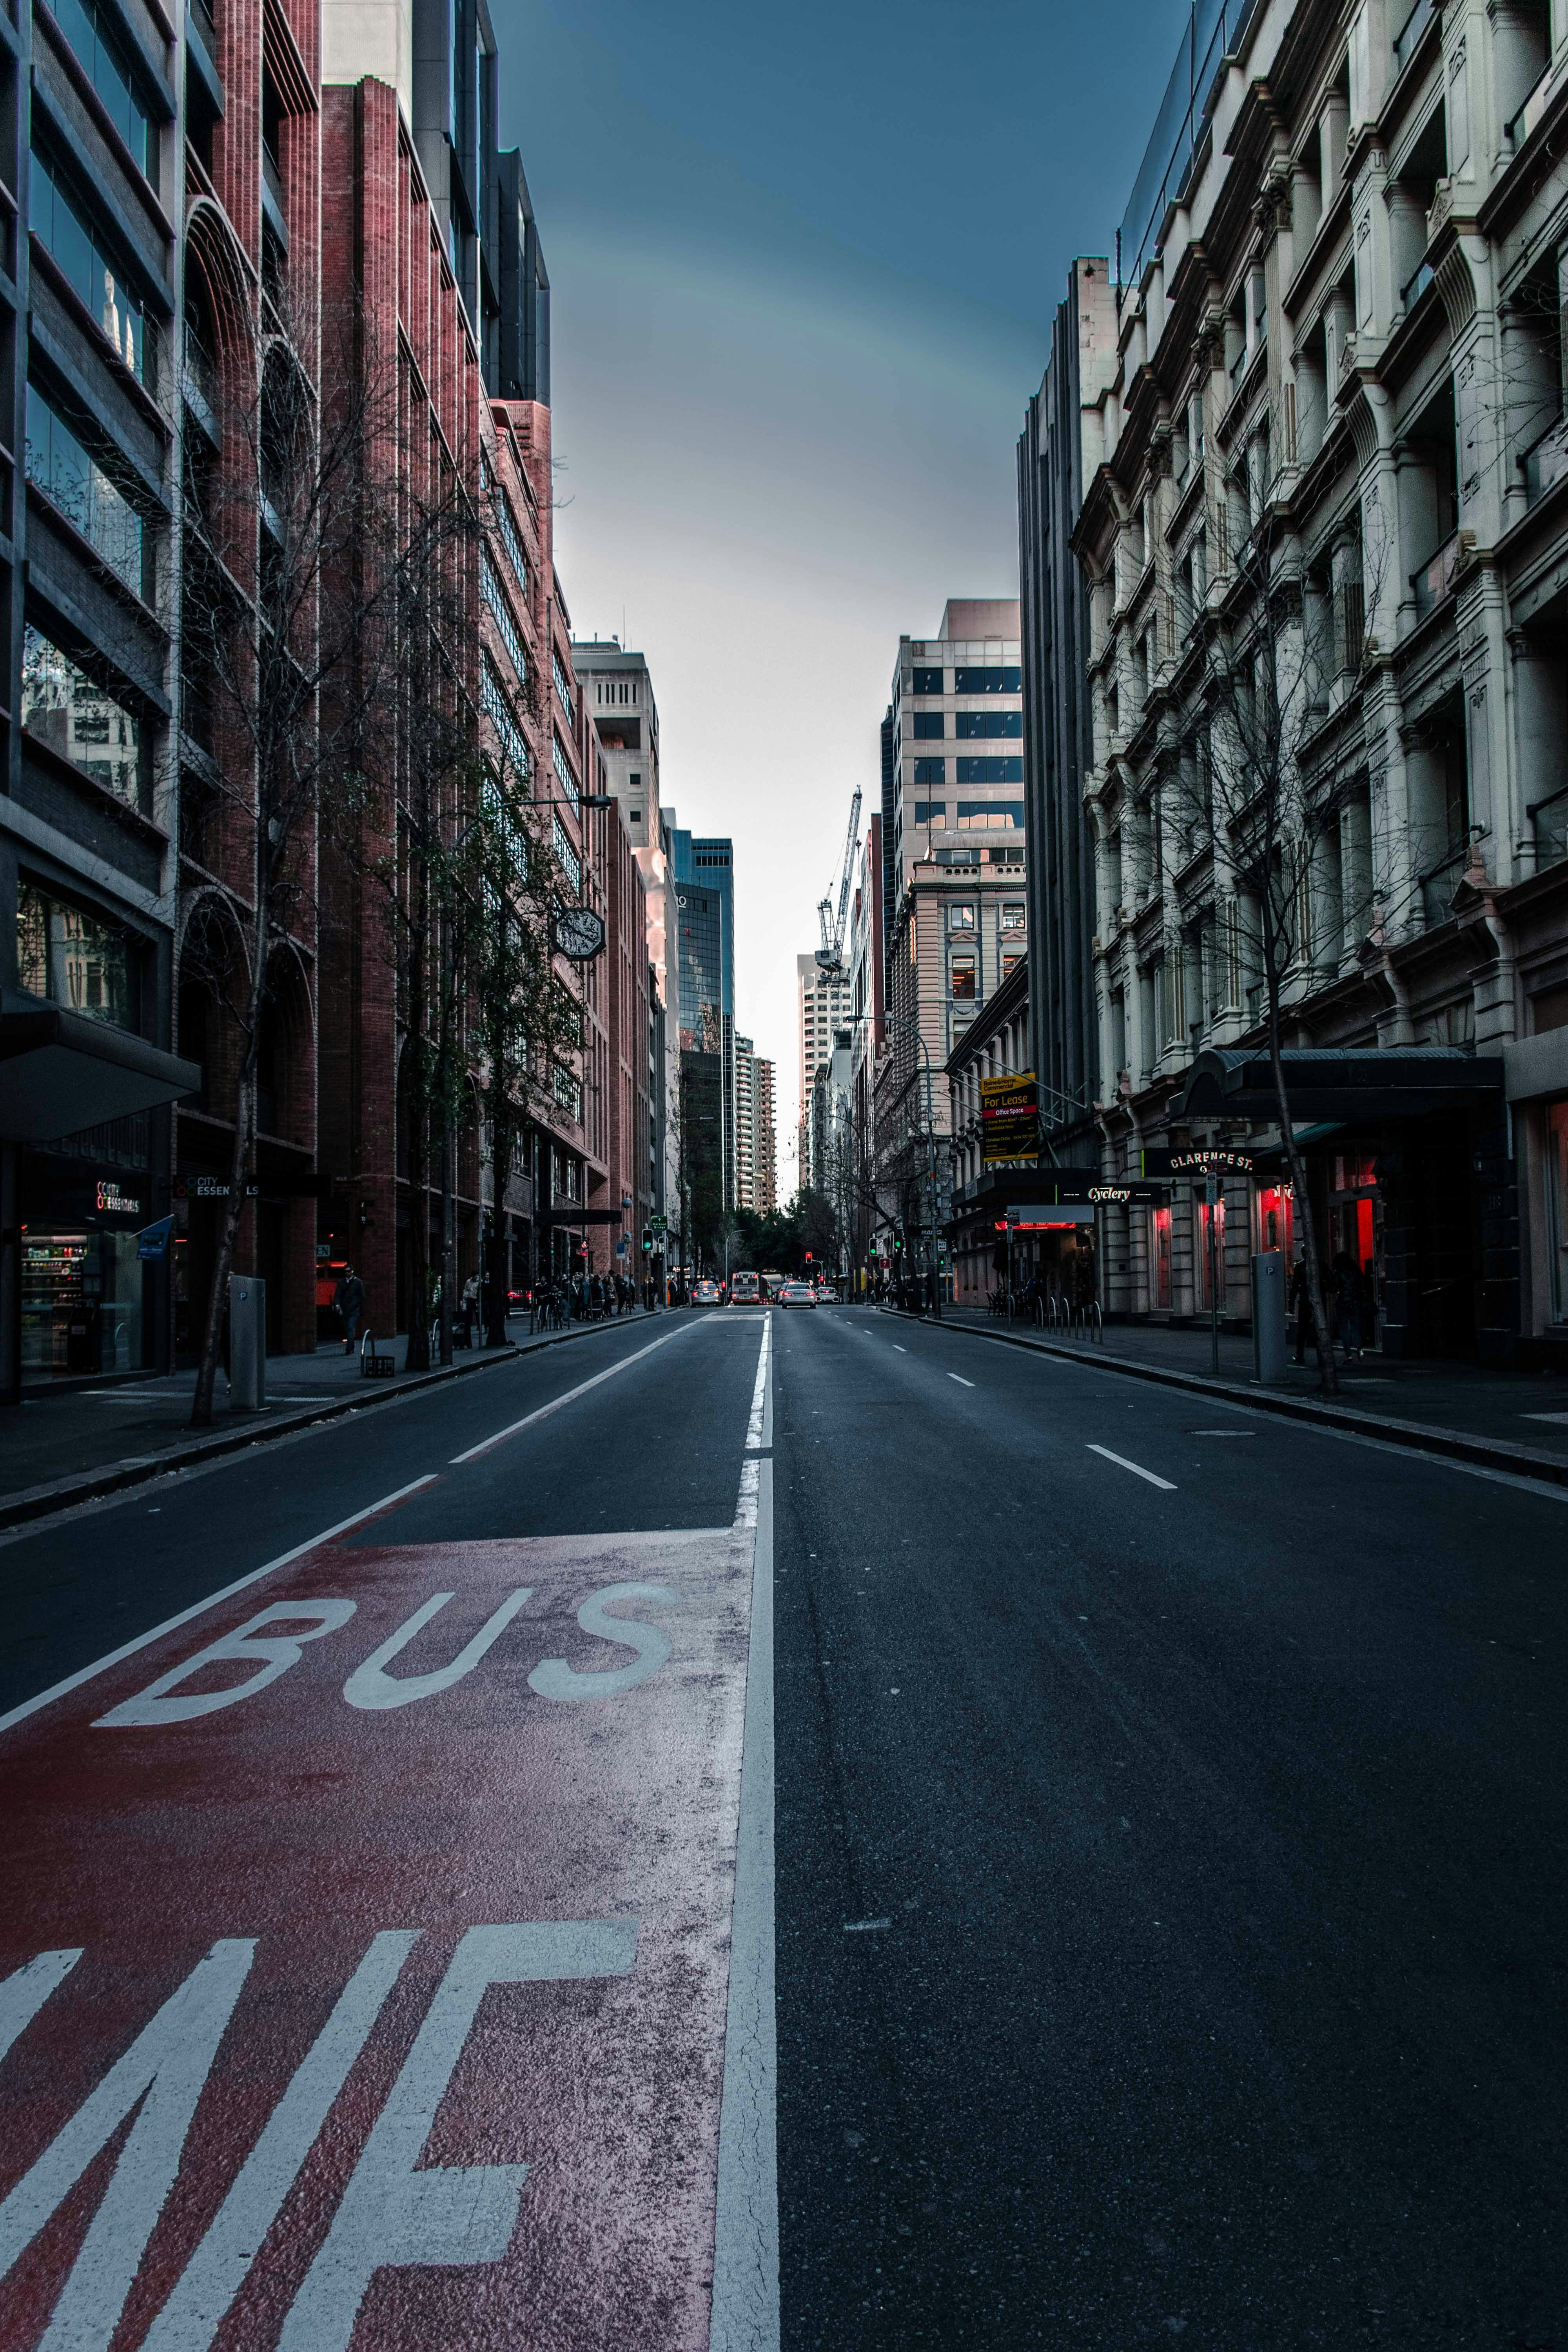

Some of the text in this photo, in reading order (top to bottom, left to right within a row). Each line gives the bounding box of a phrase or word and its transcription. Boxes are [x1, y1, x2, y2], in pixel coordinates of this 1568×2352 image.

[984, 1083, 1013, 1091] Commercial
[984, 1094, 1028, 1108] For Lease
[1170, 1152, 1235, 1169] CLARENCE
[1237, 1156, 1254, 1171] ST.
[198, 1176, 218, 1185] CITY
[198, 1186, 259, 1196] ESSENLS
[1088, 1187, 1131, 1202] Cyclery
[89, 1581, 677, 1727] BUS
